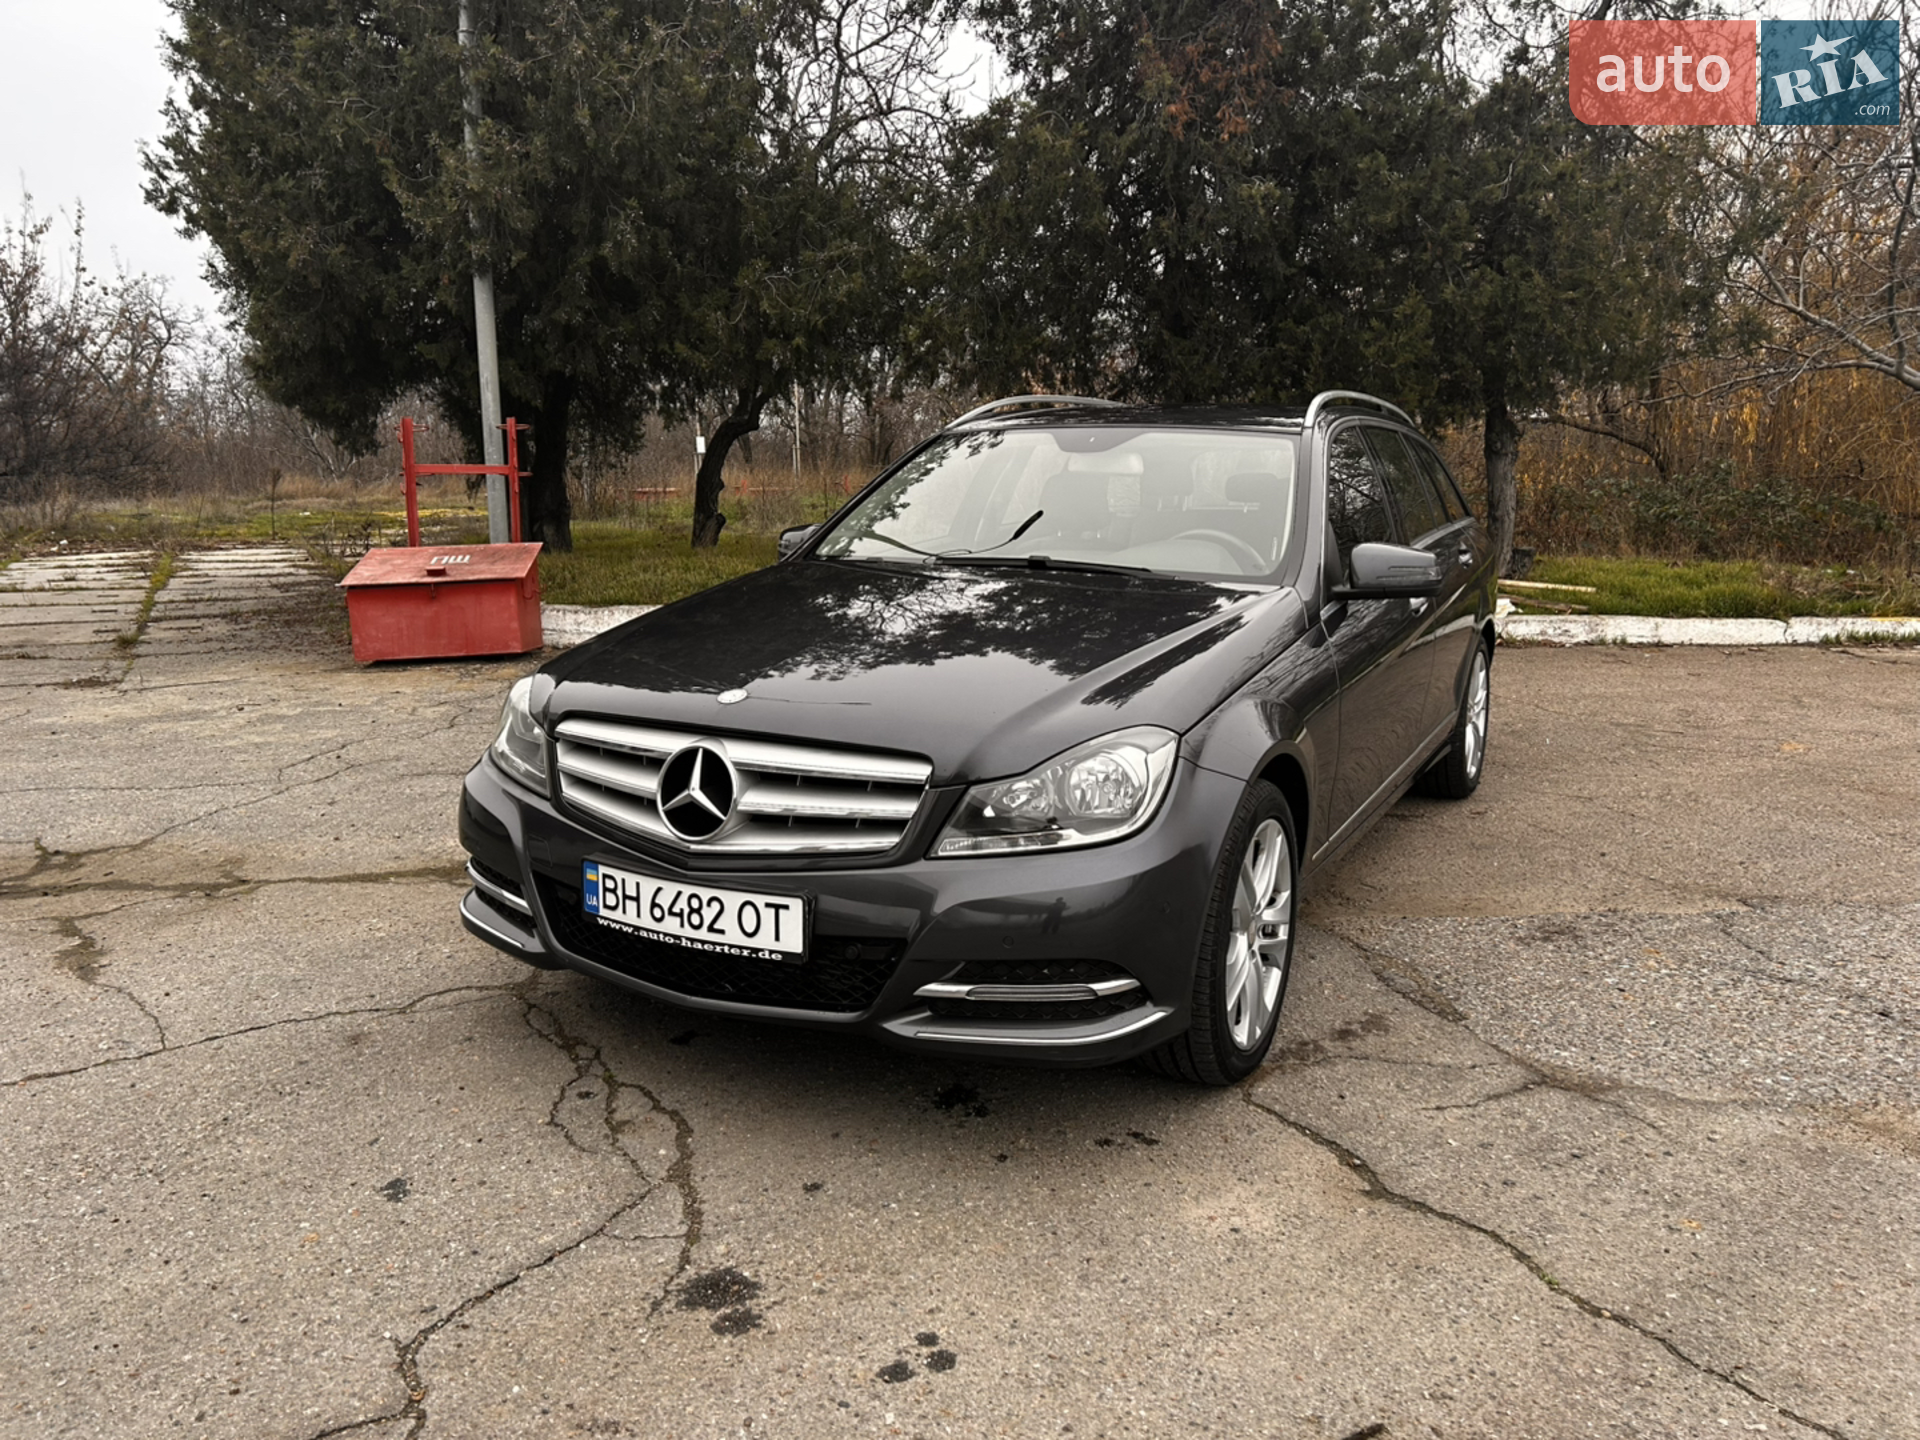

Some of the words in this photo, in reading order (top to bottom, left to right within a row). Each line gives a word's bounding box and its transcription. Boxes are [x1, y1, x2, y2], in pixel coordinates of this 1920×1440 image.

[586, 894, 598, 907] UA
[601, 872, 641, 919] BH
[650, 886, 725, 936] 6482
[737, 900, 790, 942] OT
[596, 916, 783, 961] www.auto-haerter.de
